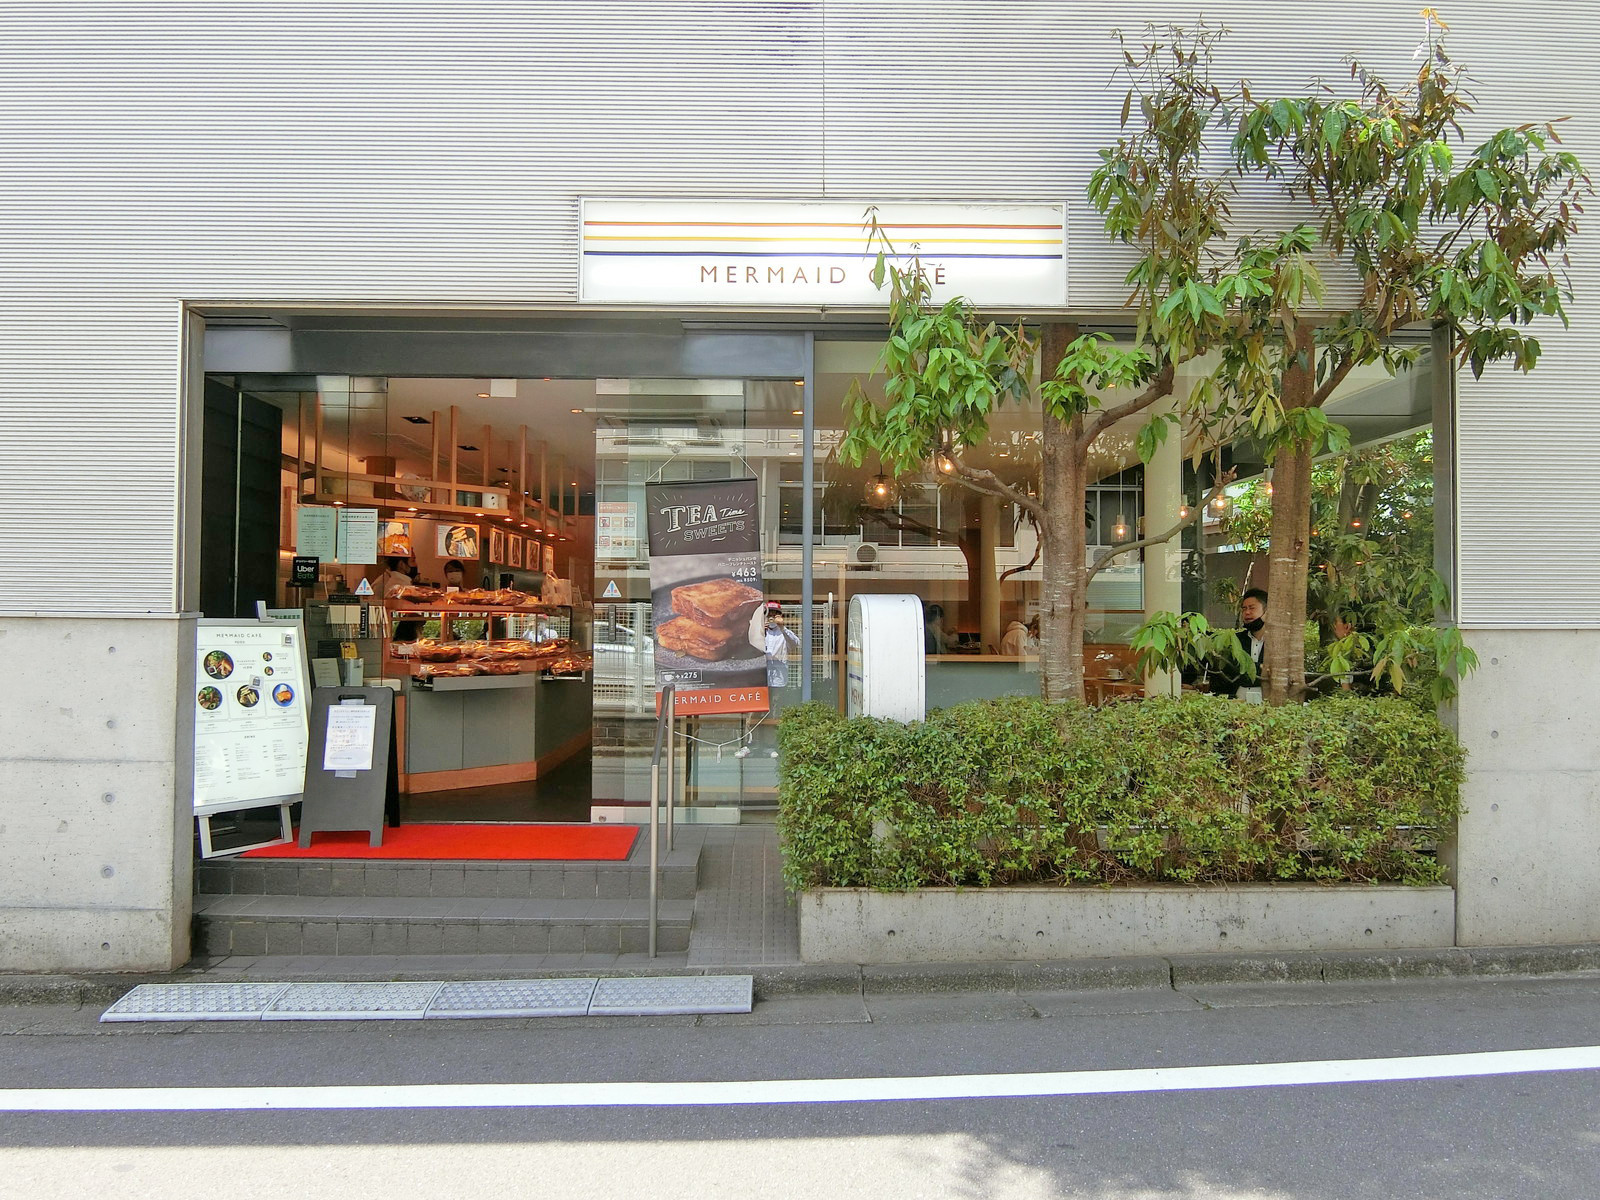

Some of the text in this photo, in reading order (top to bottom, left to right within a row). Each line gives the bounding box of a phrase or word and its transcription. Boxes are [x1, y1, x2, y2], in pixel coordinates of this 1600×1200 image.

[700, 265, 846, 284] MERMAID
[660, 504, 745, 533] TEA Time
[683, 520, 745, 541] SWEETS
[296, 565, 315, 573] Uber
[674, 691, 761, 705] ERMAID CAFÉ
